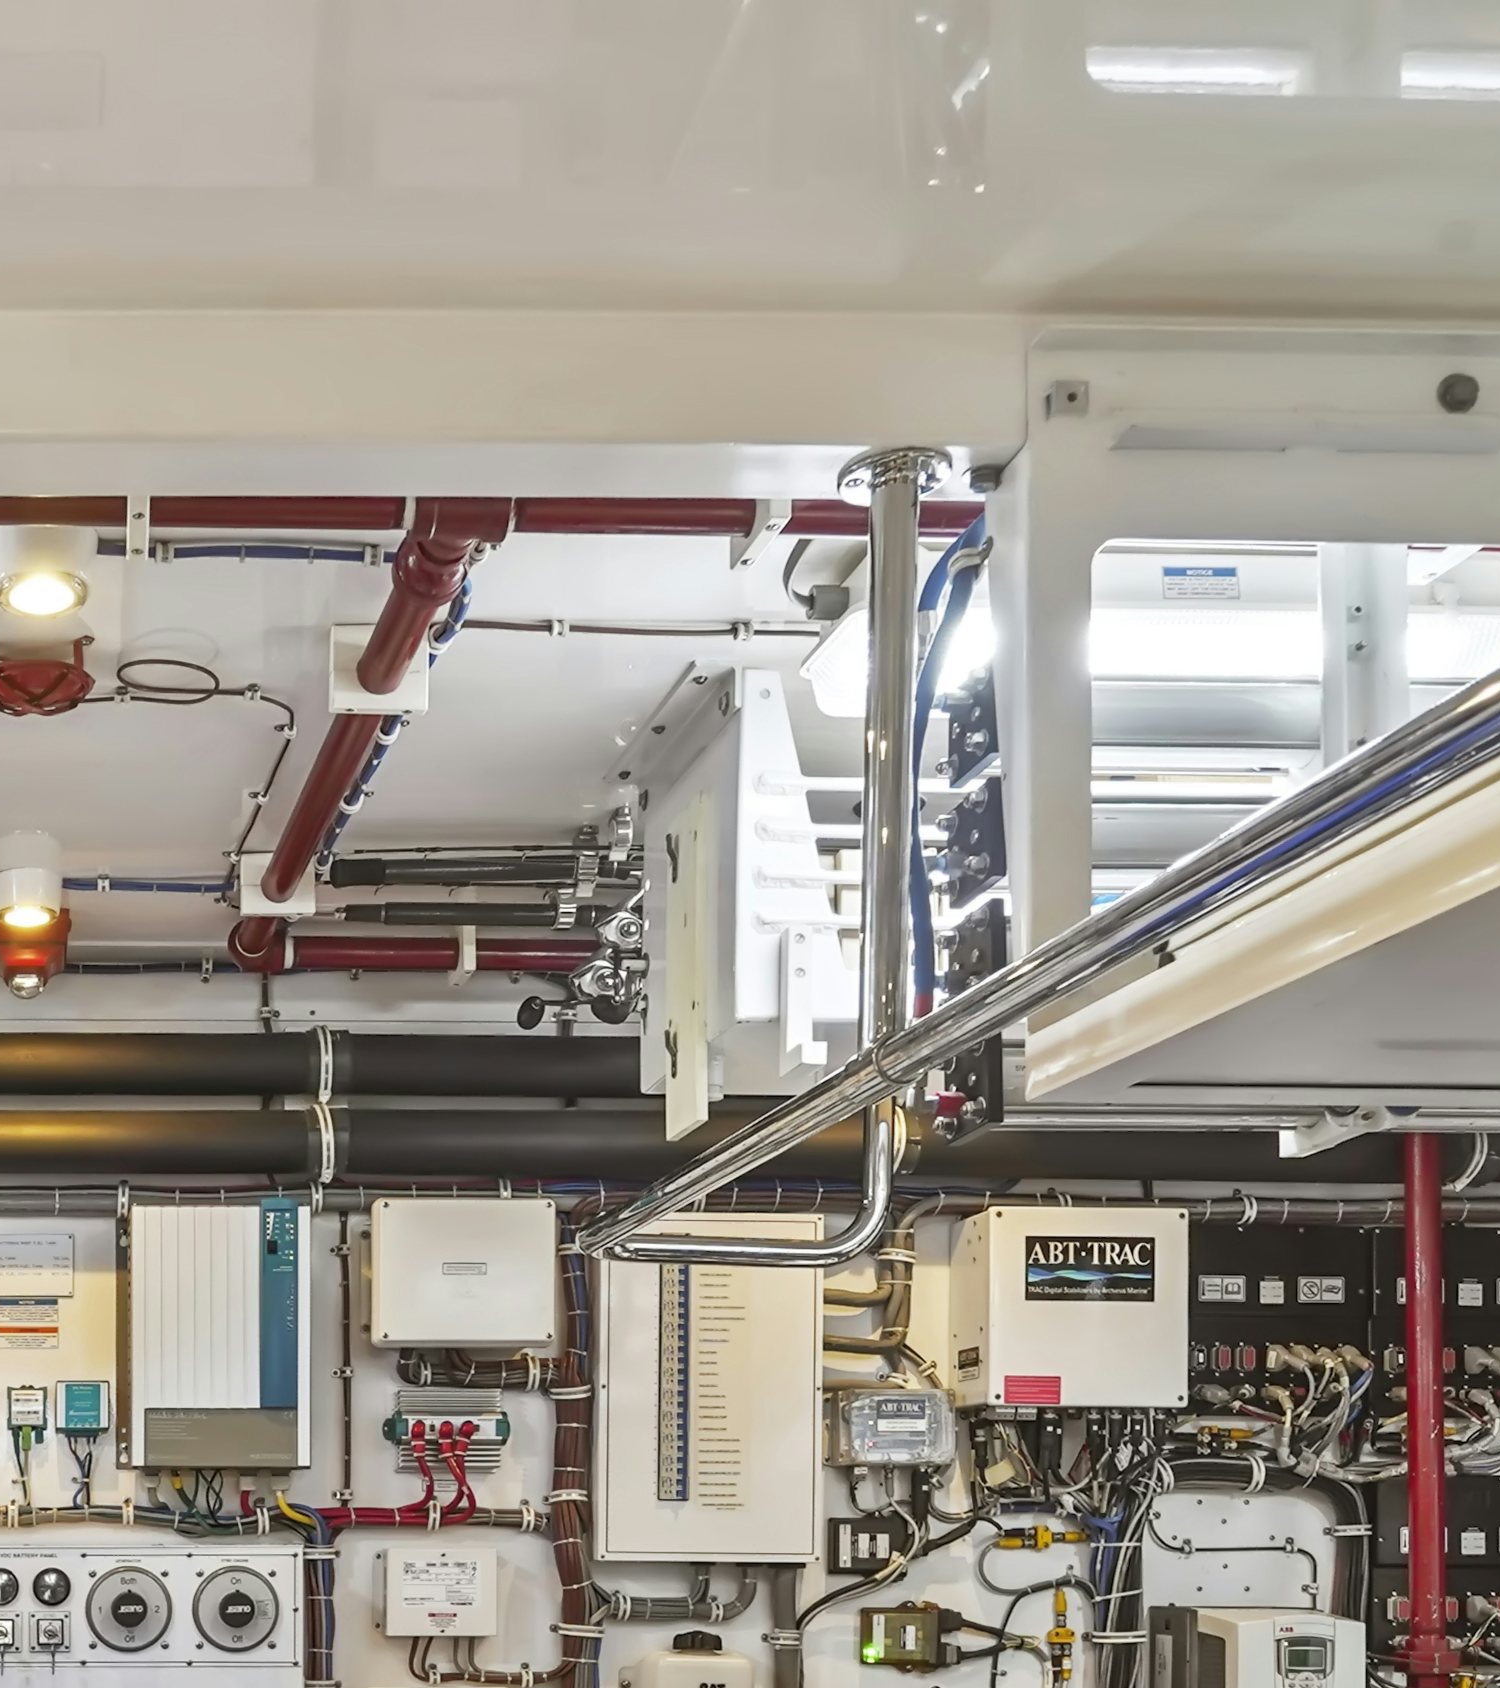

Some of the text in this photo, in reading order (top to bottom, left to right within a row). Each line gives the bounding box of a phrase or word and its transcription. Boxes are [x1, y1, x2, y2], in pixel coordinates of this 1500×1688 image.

[120, 1577, 137, 1585] Both
[230, 1577, 242, 1585] On
[154, 1605, 160, 1613] 2
[124, 1635, 135, 1643] Off
[232, 1635, 244, 1643] Off
